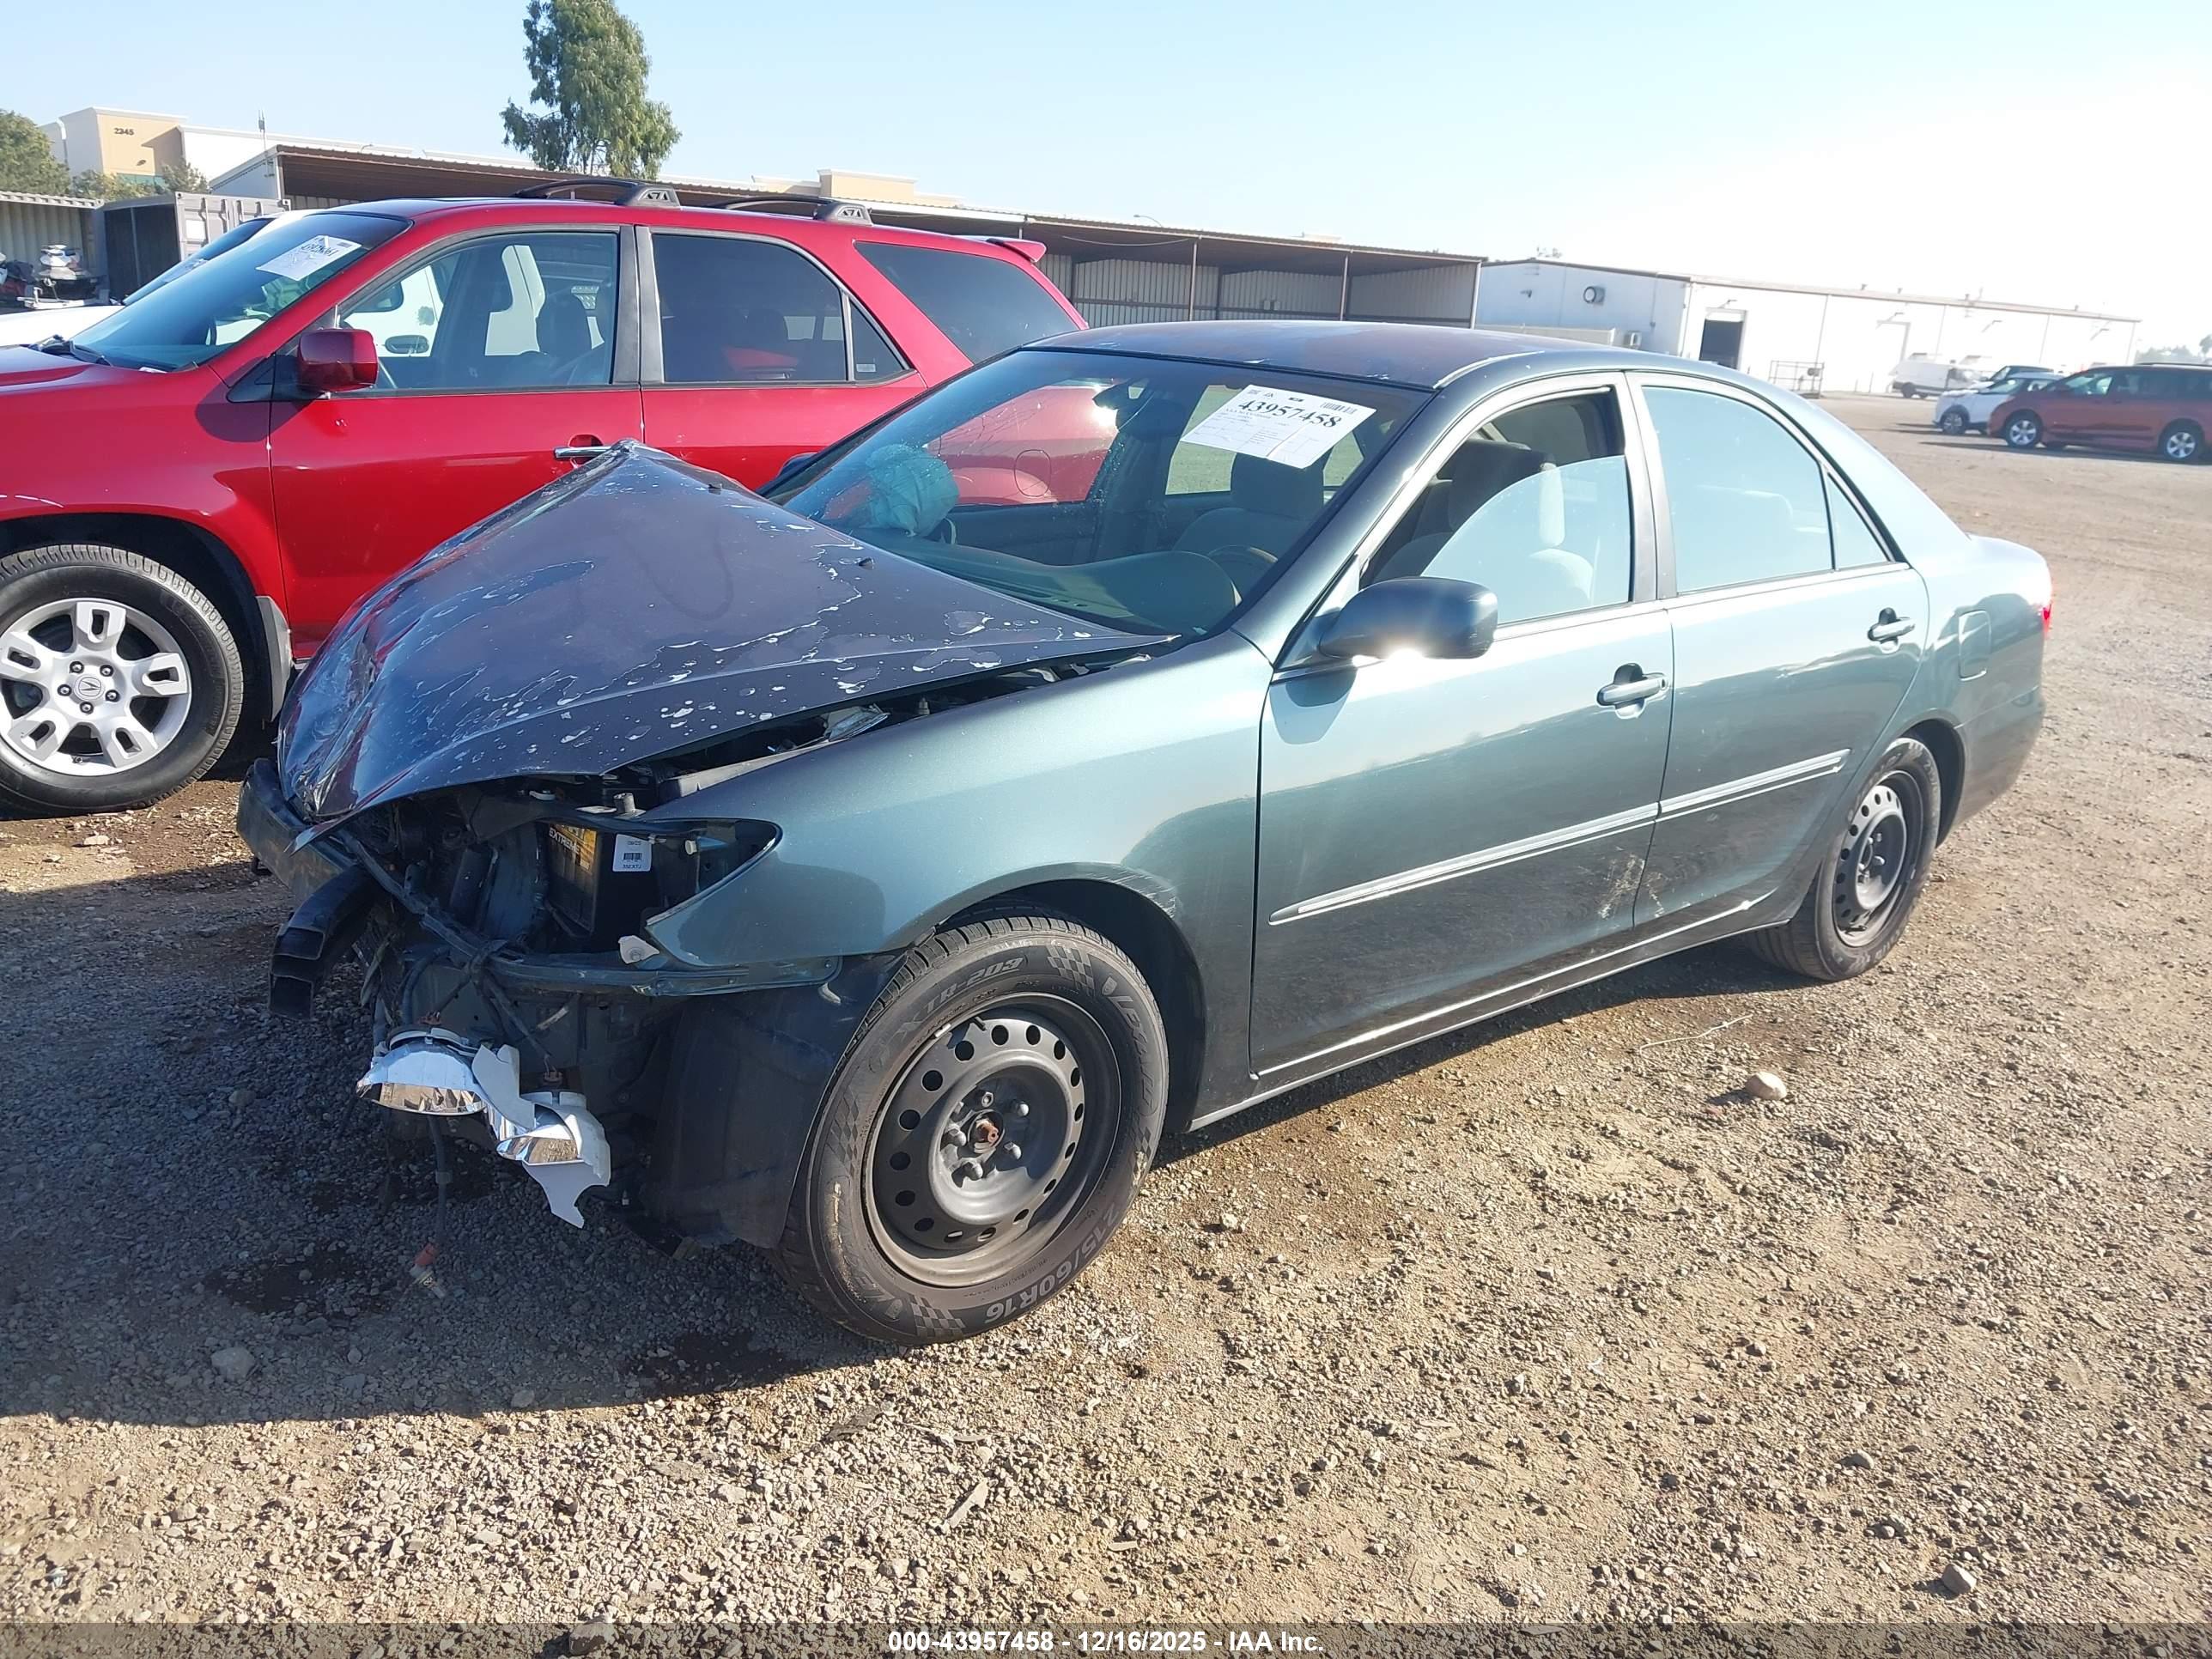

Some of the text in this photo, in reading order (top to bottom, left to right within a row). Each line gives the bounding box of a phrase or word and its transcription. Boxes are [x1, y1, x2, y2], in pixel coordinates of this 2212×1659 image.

[113, 127, 135, 136] 2345
[1238, 399, 1342, 428] 43957458
[549, 827, 580, 854] EXTREME
[984, 1202, 1120, 1324] 215/60R16
